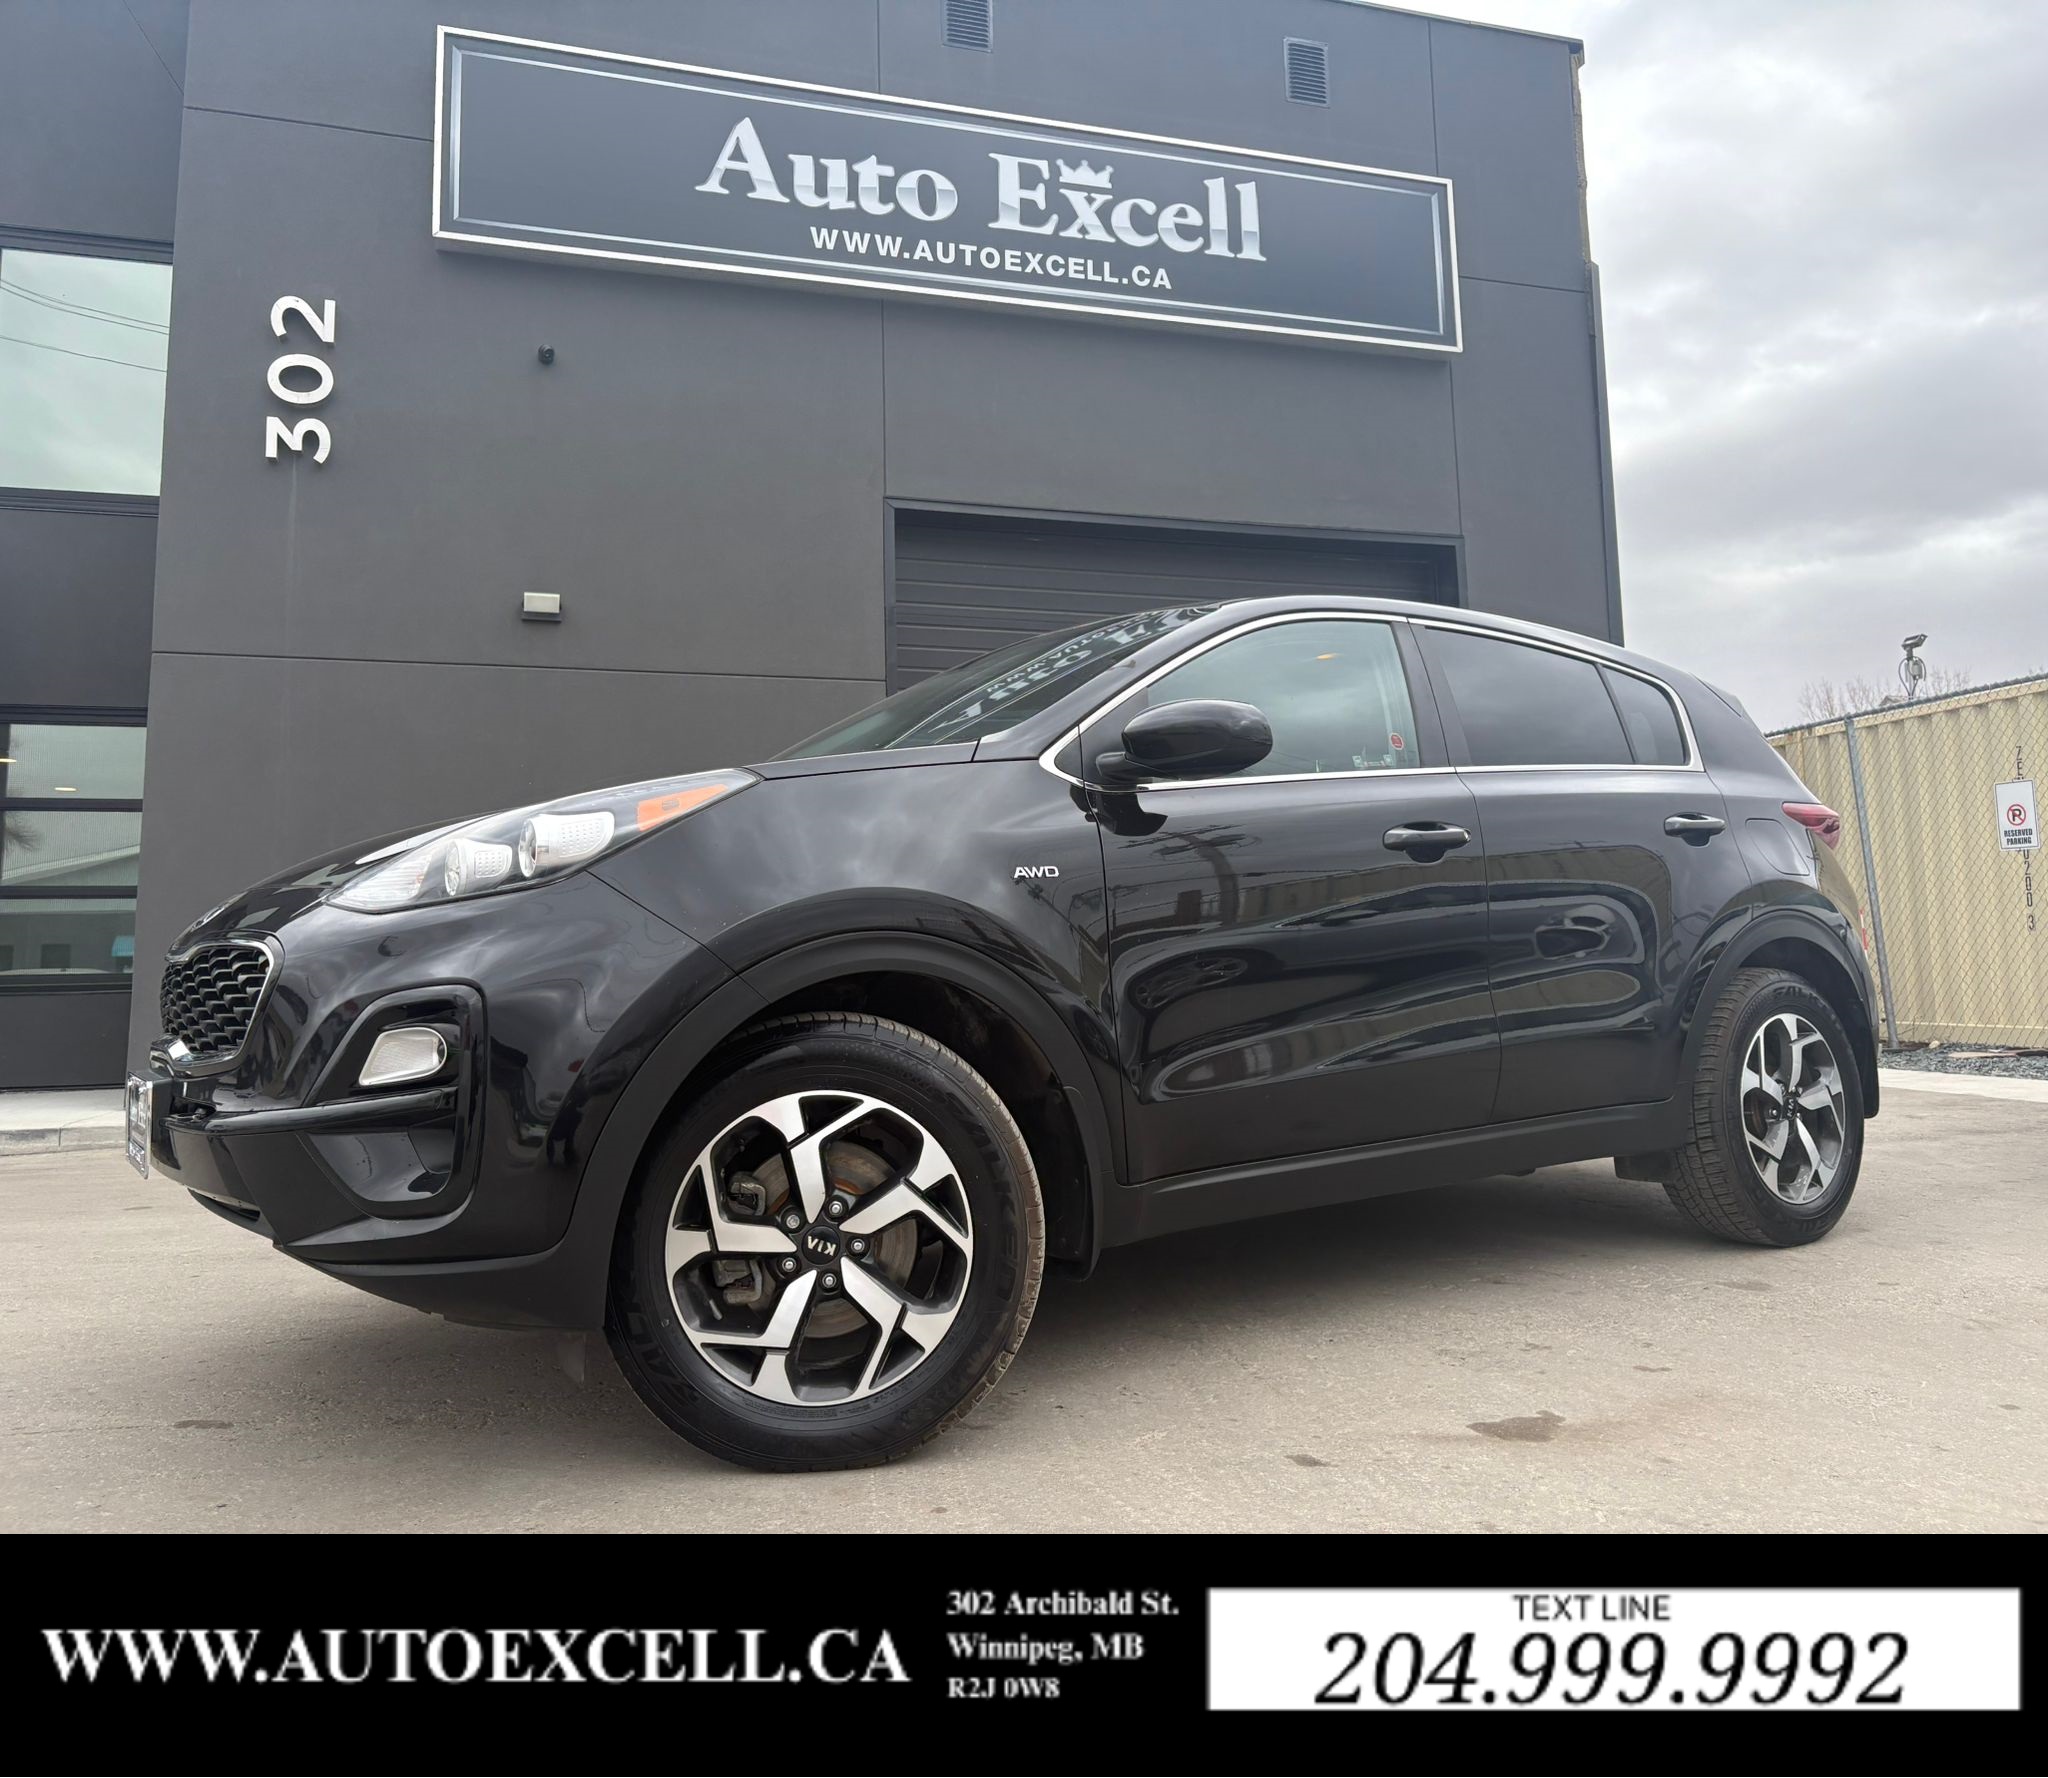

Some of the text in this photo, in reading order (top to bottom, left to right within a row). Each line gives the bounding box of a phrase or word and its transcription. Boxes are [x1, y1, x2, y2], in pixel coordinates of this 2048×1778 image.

[694, 116, 1267, 262] Auto Excell
[810, 226, 1172, 289] WWW.AUTOEXCELL.CA
[265, 295, 337, 465] 302
[2003, 828, 2033, 838] RESERVED
[2006, 836, 2032, 846] PARKING
[1013, 865, 1060, 879] AWD
[807, 1235, 837, 1257] KIA
